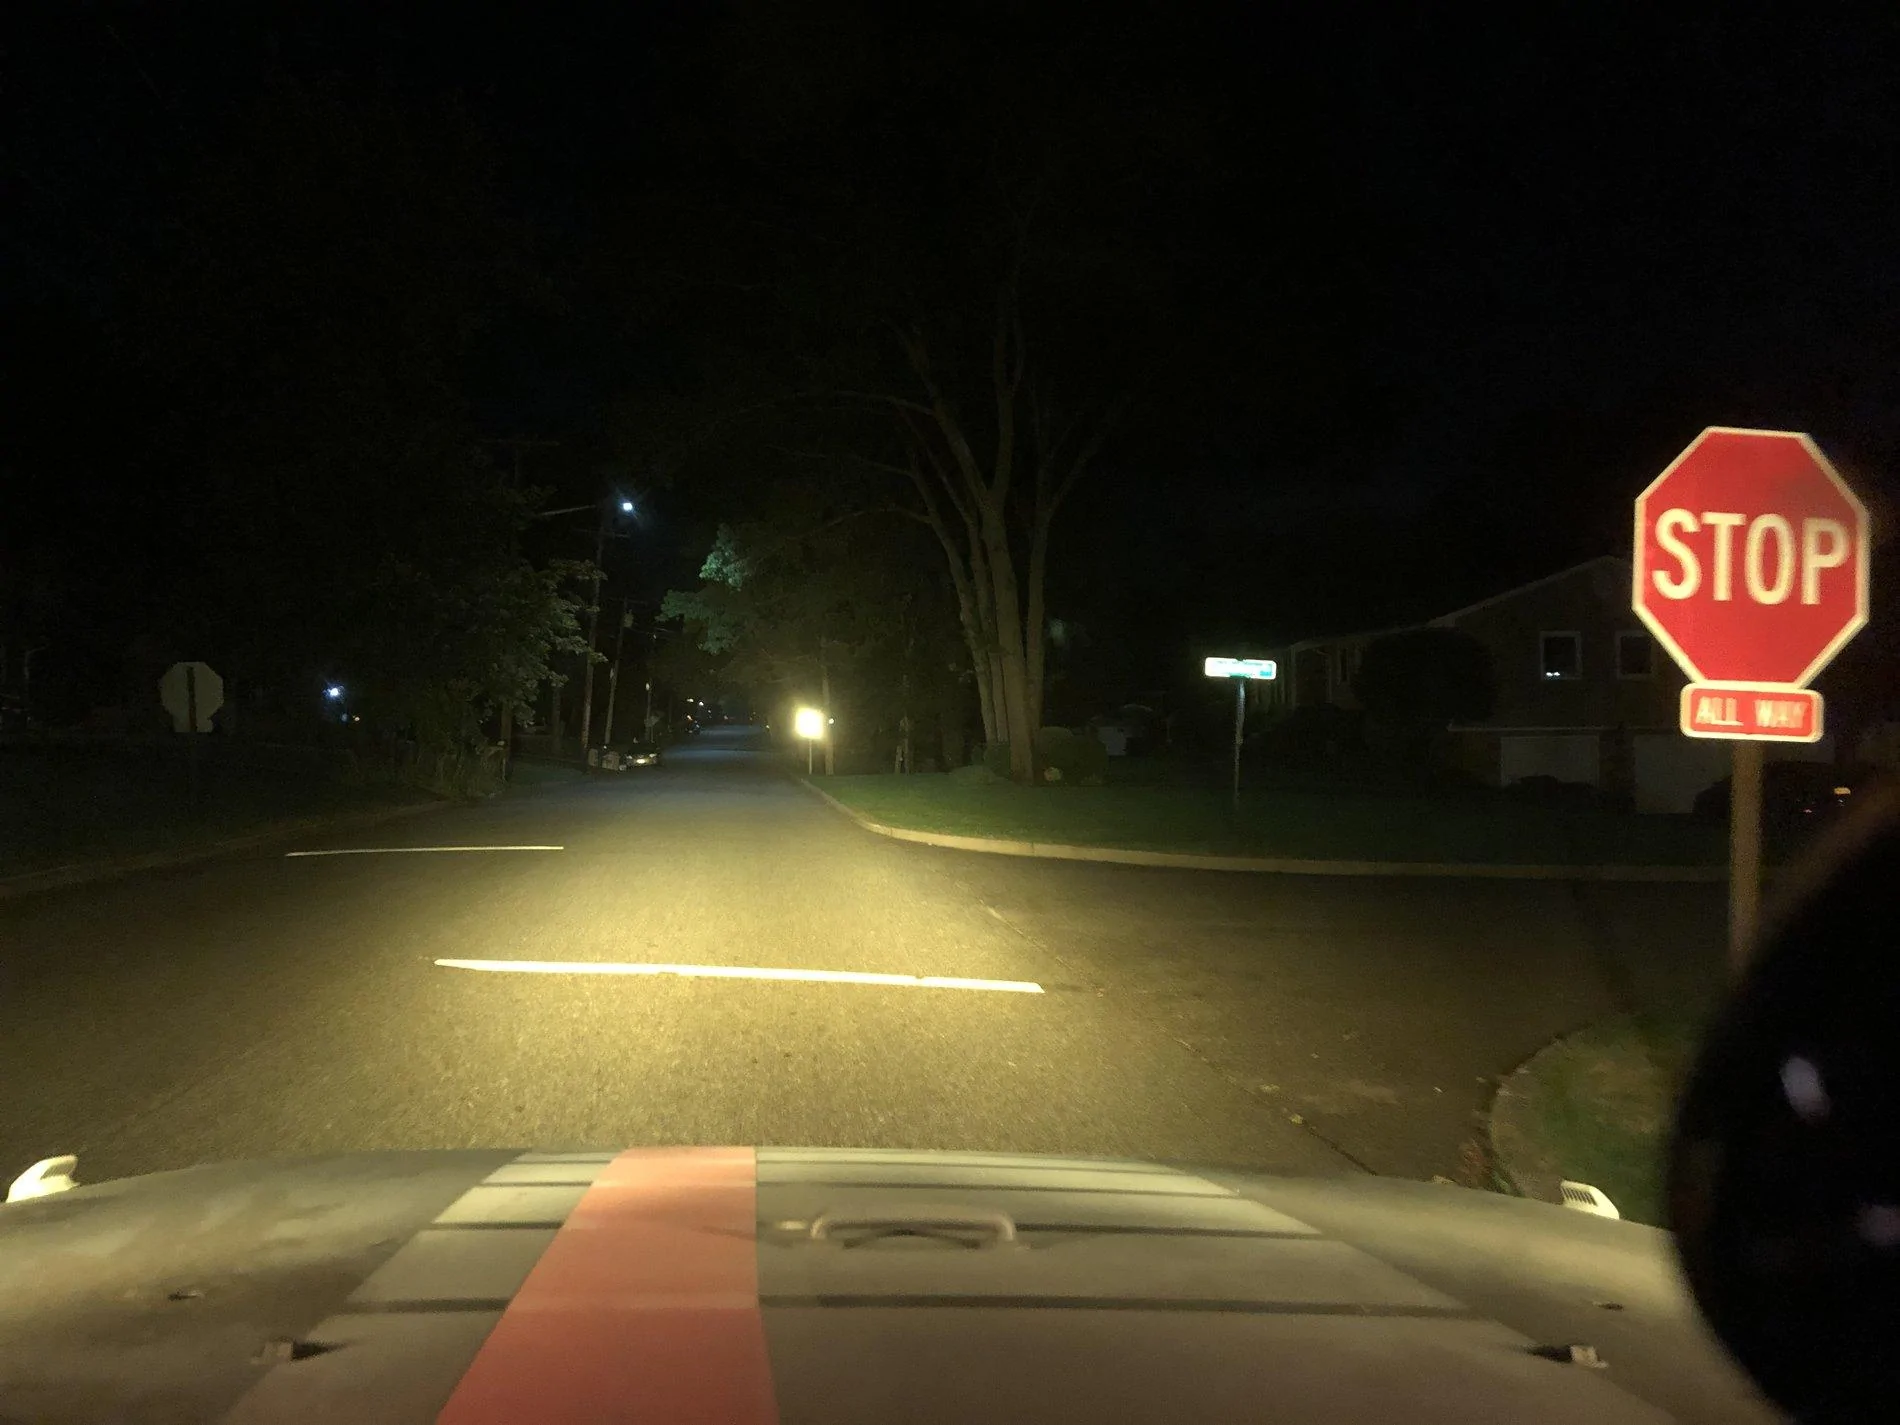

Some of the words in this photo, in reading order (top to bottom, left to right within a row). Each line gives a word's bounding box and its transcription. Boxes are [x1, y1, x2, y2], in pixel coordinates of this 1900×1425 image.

[1652, 507, 1850, 605] STOP
[1695, 696, 1744, 727] ALL
[1754, 699, 1809, 729] WAY
